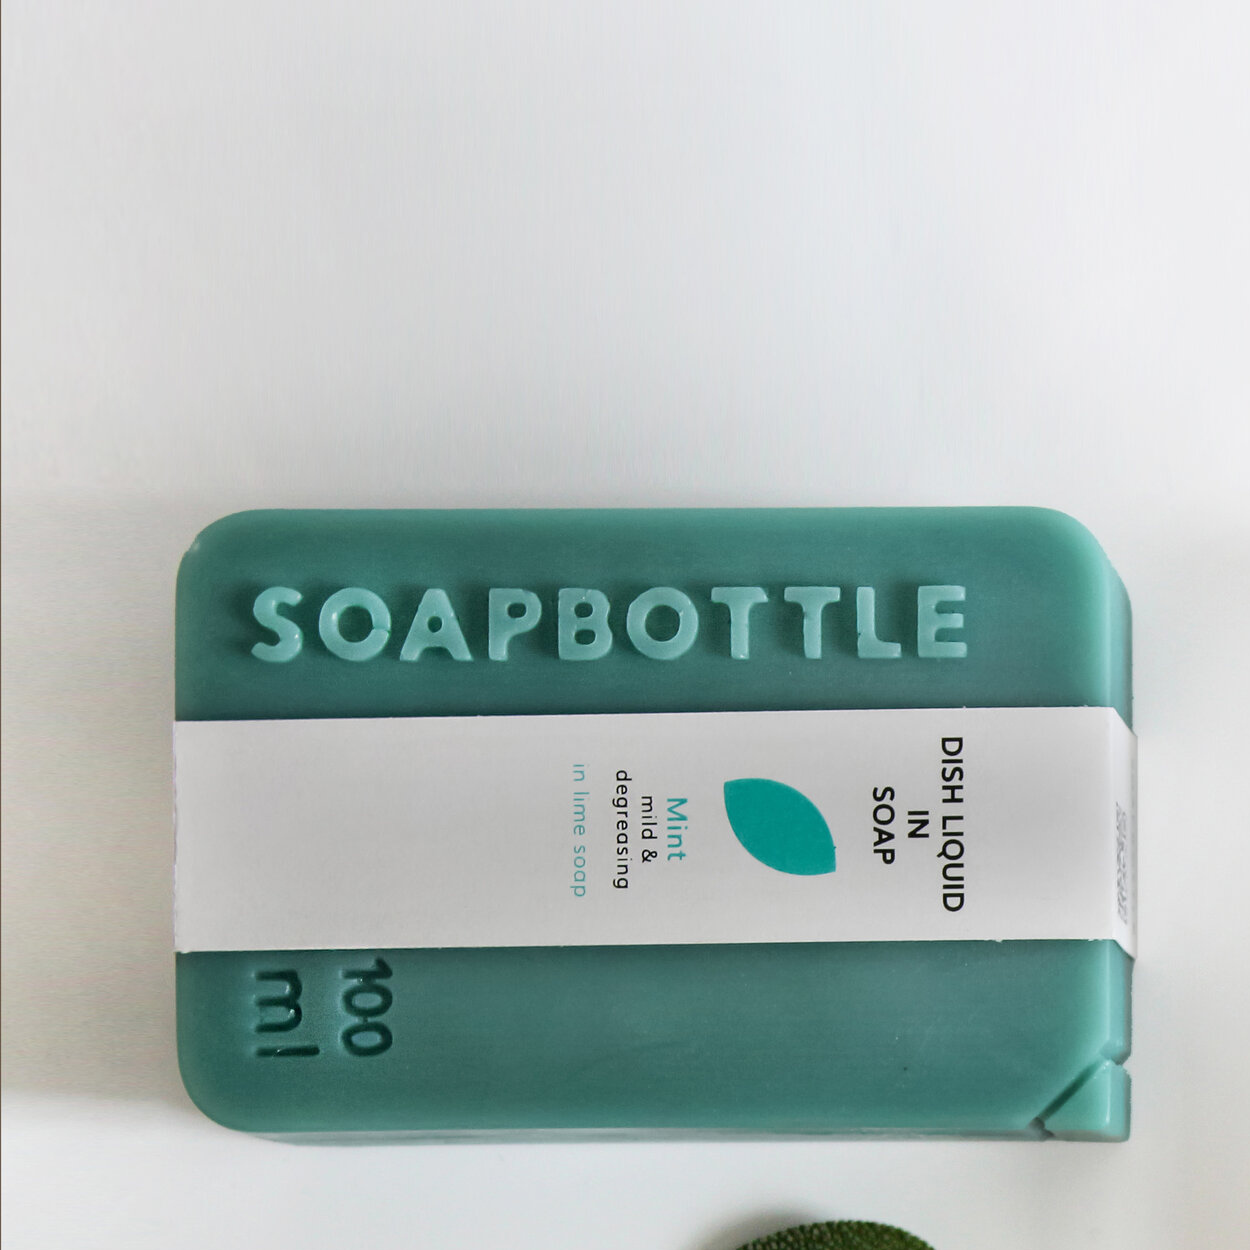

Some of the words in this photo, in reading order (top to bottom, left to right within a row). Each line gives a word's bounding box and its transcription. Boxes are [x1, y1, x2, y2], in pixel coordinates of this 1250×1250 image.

[251, 584, 968, 663] SOAPBOTTLE
[572, 763, 591, 783] in
[941, 736, 965, 804] DISH
[573, 791, 591, 836] lime
[611, 769, 633, 890] degreasing
[641, 795, 659, 840] mild
[666, 797, 689, 862] Mint
[872, 786, 896, 865] SOAP
[907, 810, 930, 839] IN
[570, 845, 587, 898] soap
[641, 849, 659, 864] &
[936, 815, 966, 913] LIQUID
[254, 969, 321, 1058] ml
[340, 956, 394, 1058] 100
